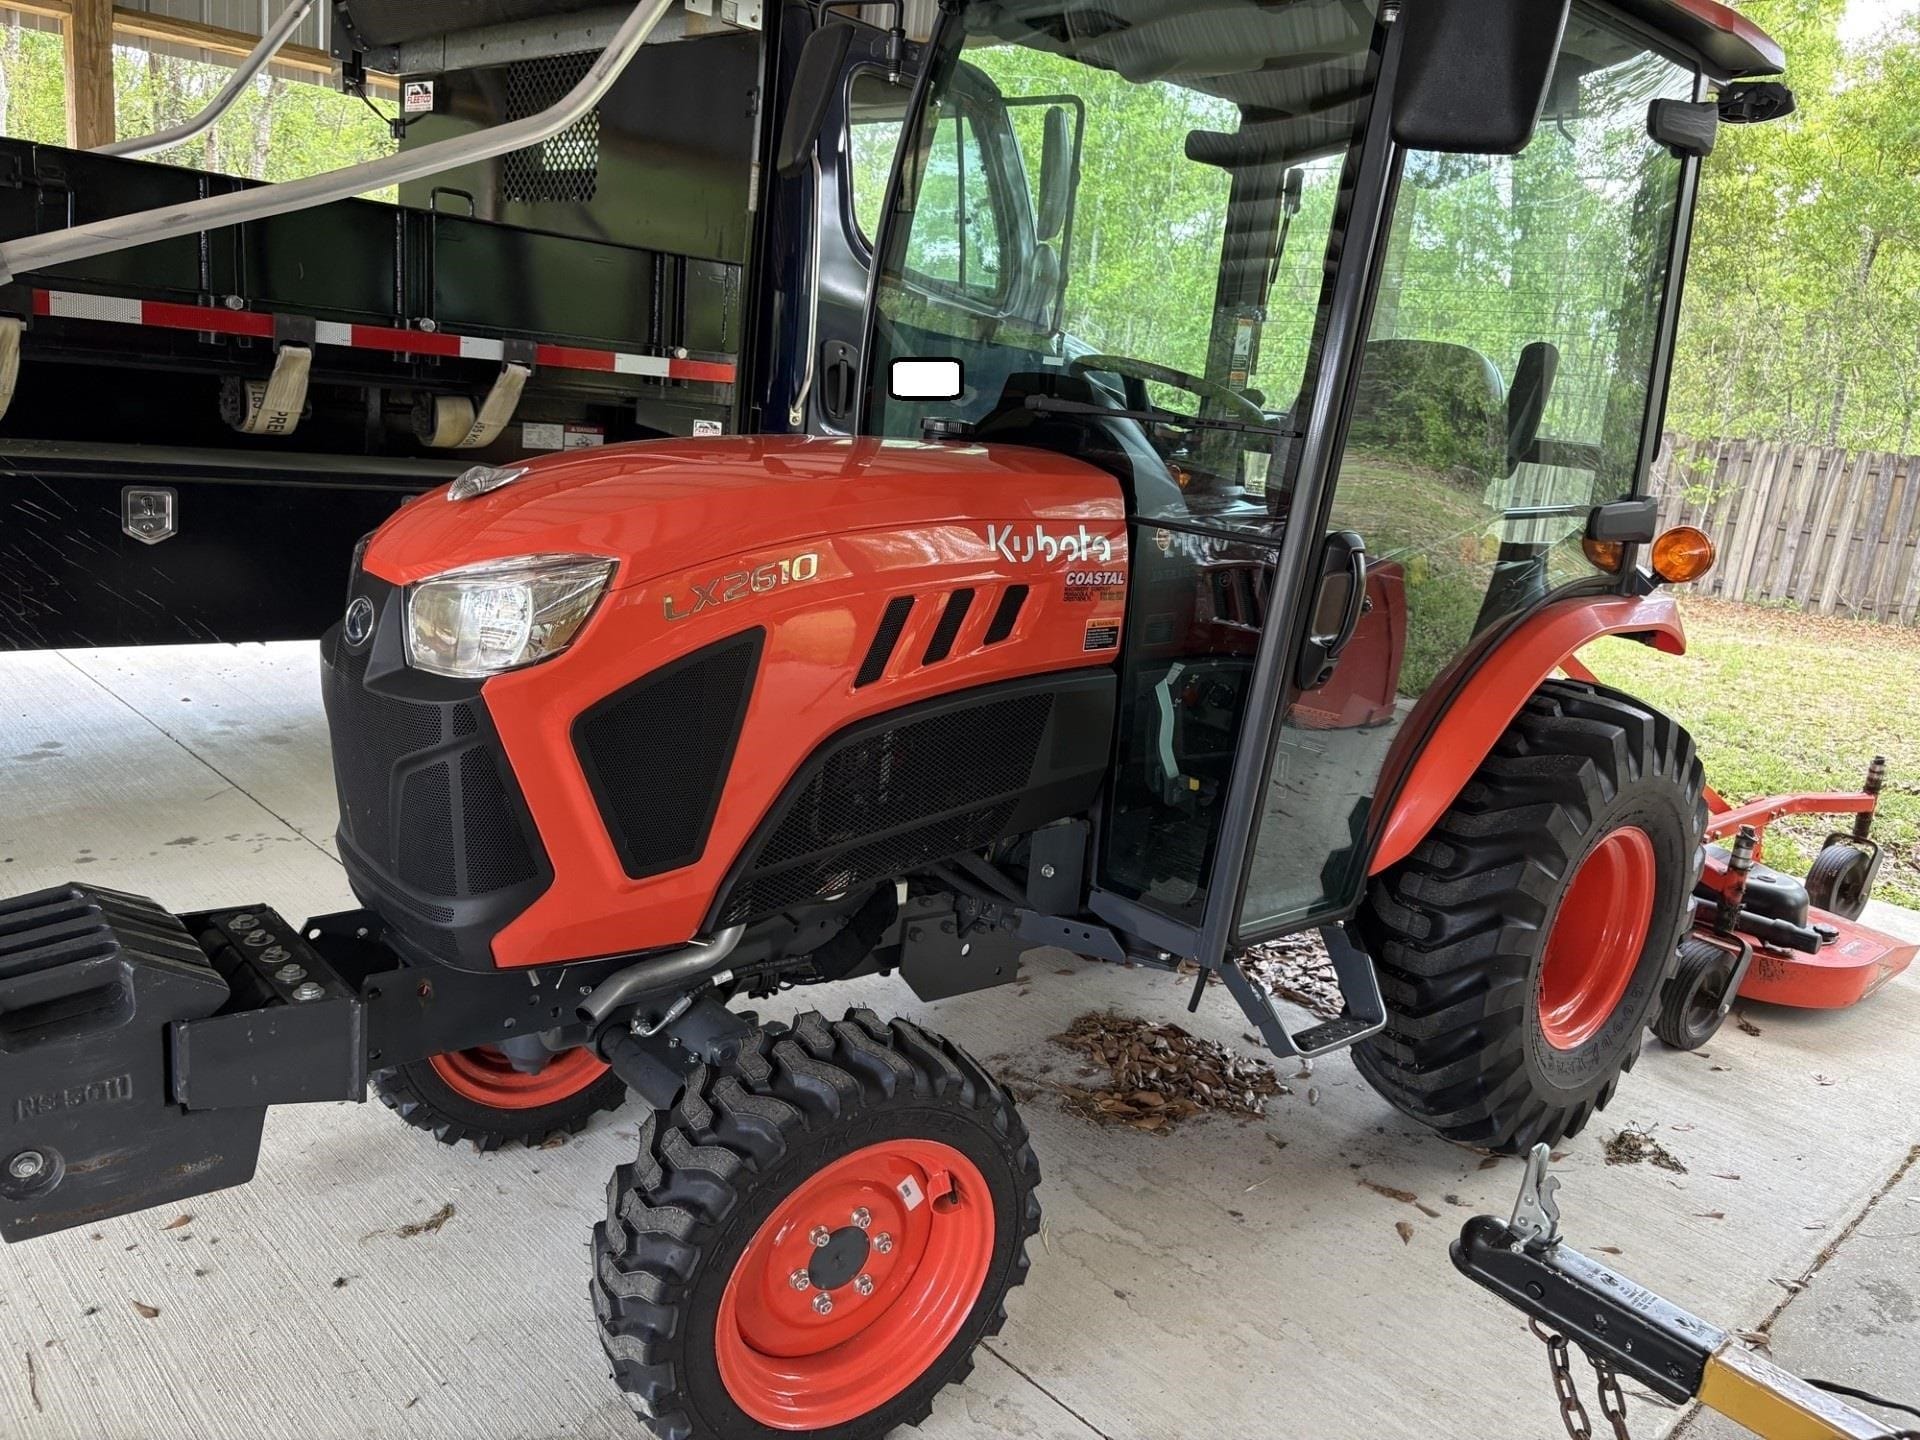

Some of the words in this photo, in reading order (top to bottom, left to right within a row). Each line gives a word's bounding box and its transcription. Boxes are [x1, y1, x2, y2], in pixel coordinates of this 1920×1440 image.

[407, 96, 431, 104] FLEETCO
[987, 524, 1111, 562] Kubota
[663, 553, 819, 621] LX2610
[1065, 571, 1125, 586] COASTAL
